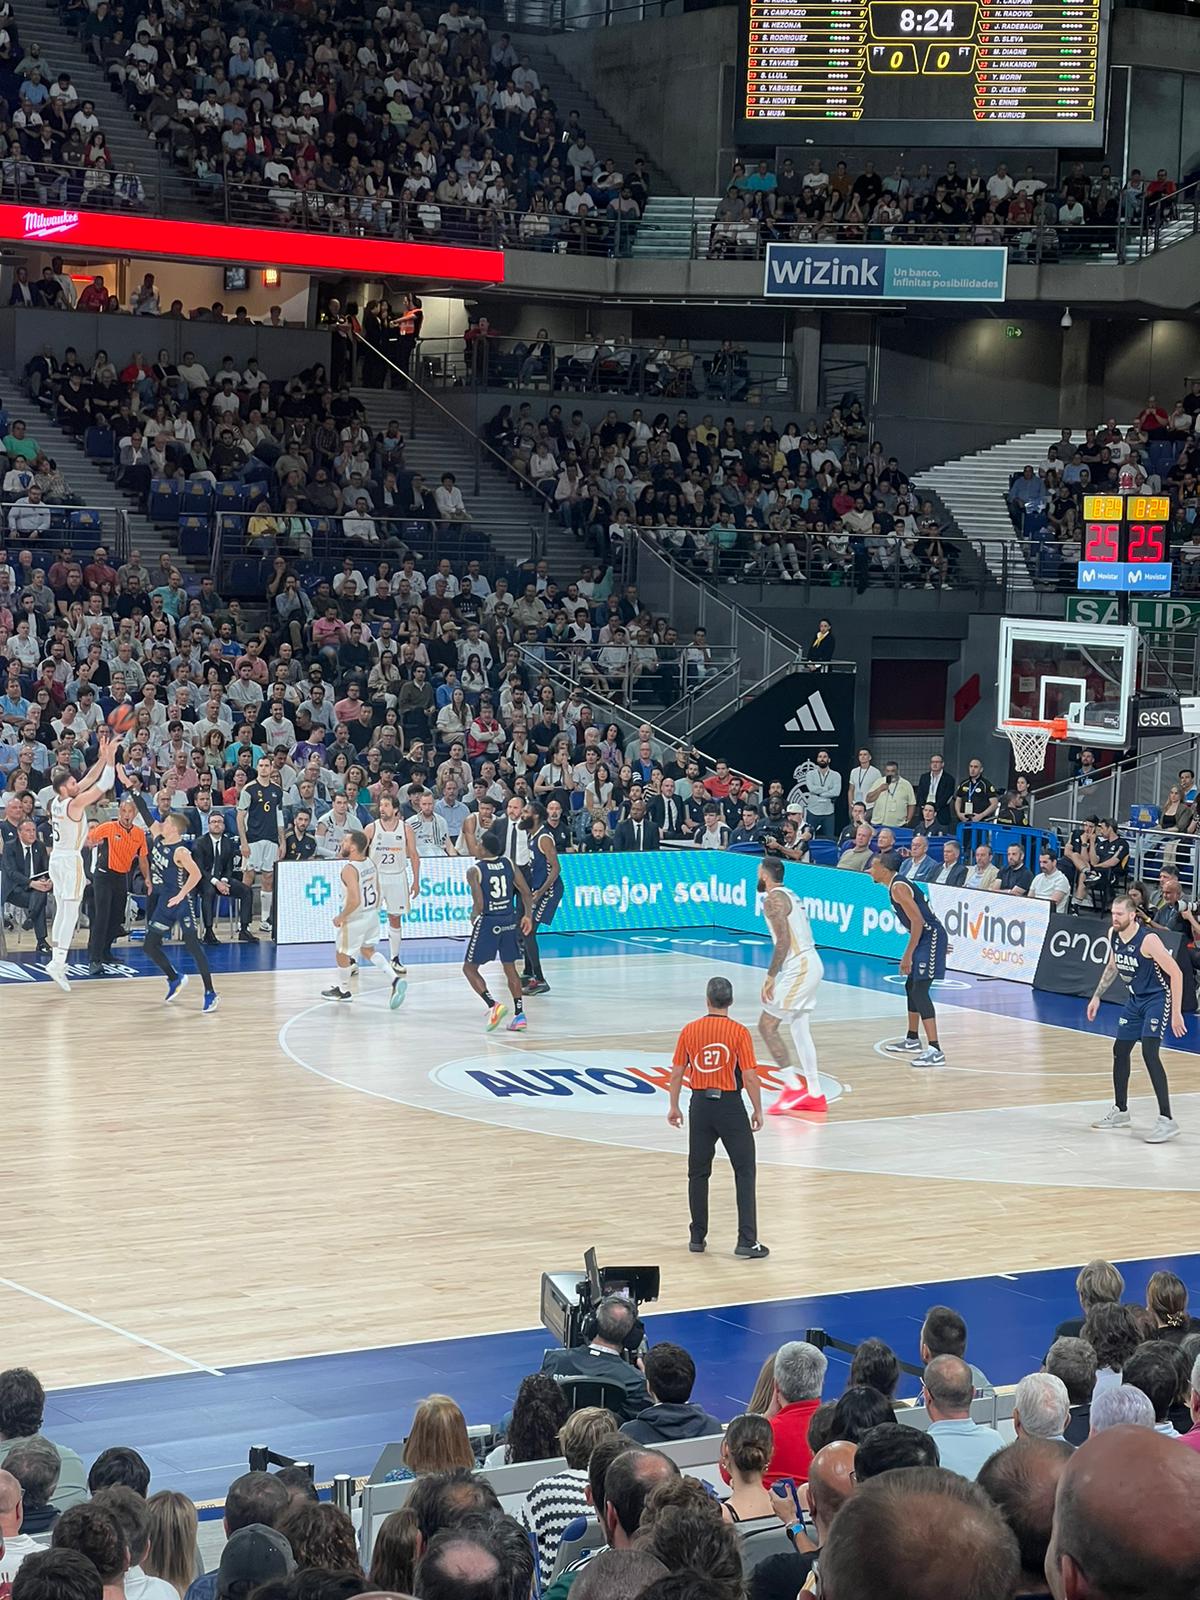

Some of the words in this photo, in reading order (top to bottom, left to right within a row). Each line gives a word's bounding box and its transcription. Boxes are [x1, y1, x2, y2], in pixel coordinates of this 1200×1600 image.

[900, 9, 955, 32] 8:24
[873, 46, 886, 56] FT
[890, 51, 904, 69] 0
[937, 51, 951, 69] 0
[958, 47, 971, 56] FT
[22, 210, 79, 231] Milwaukee
[771, 256, 879, 286] WiZink
[894, 267, 907, 277] Un
[909, 267, 941, 278] banco.
[893, 278, 932, 288] Infinitas
[933, 278, 999, 289] posibilidades
[1093, 498, 1122, 518] 8:24
[1135, 499, 1169, 519] 8:24
[1086, 525, 1119, 562] 25
[1128, 525, 1163, 563] 25
[1075, 600, 1200, 628] SALID
[1138, 711, 1171, 727] esa
[381, 853, 396, 865] 23
[363, 884, 377, 908] 13
[489, 874, 508, 899] 31
[574, 875, 663, 913] mejor
[673, 874, 748, 908] salud
[802, 896, 855, 933] muy
[944, 901, 1026, 948] divina
[981, 947, 1025, 967] seguros
[703, 1051, 721, 1065] 27
